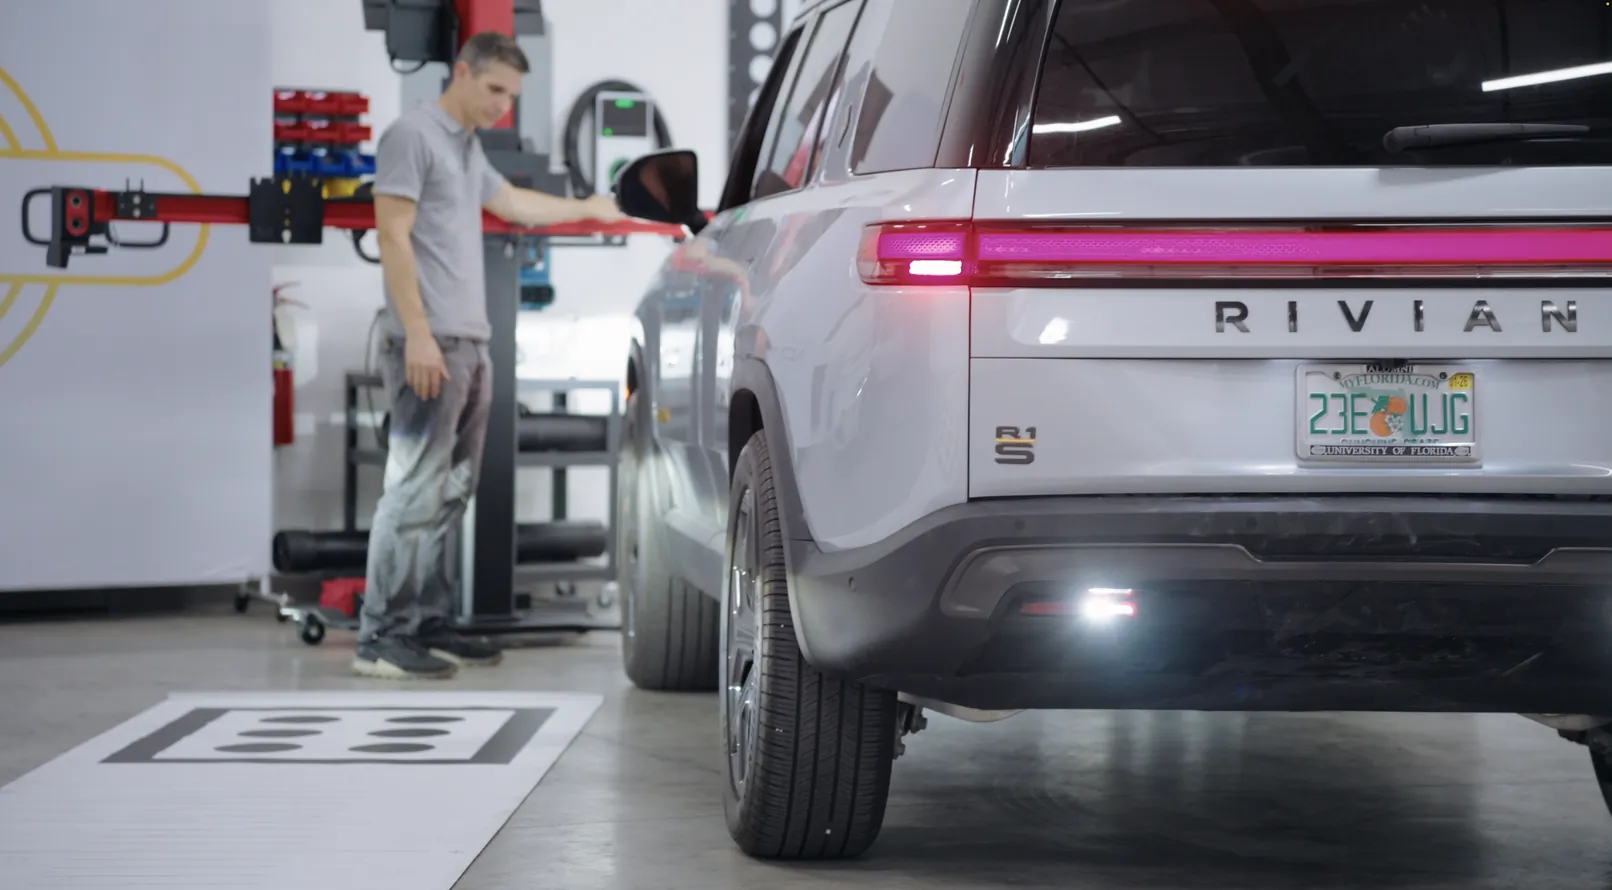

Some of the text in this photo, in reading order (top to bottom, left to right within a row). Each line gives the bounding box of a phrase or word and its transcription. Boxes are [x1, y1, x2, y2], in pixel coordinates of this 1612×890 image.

[1215, 300, 1578, 332] RIVIAN
[1340, 374, 1441, 390] MYFLORIDA.COM
[1310, 393, 1469, 435] 23E UJG
[996, 426, 1037, 440] R1
[994, 442, 1035, 465] S
[1325, 446, 1455, 455] UNIVERSITY OF FLORIDA
